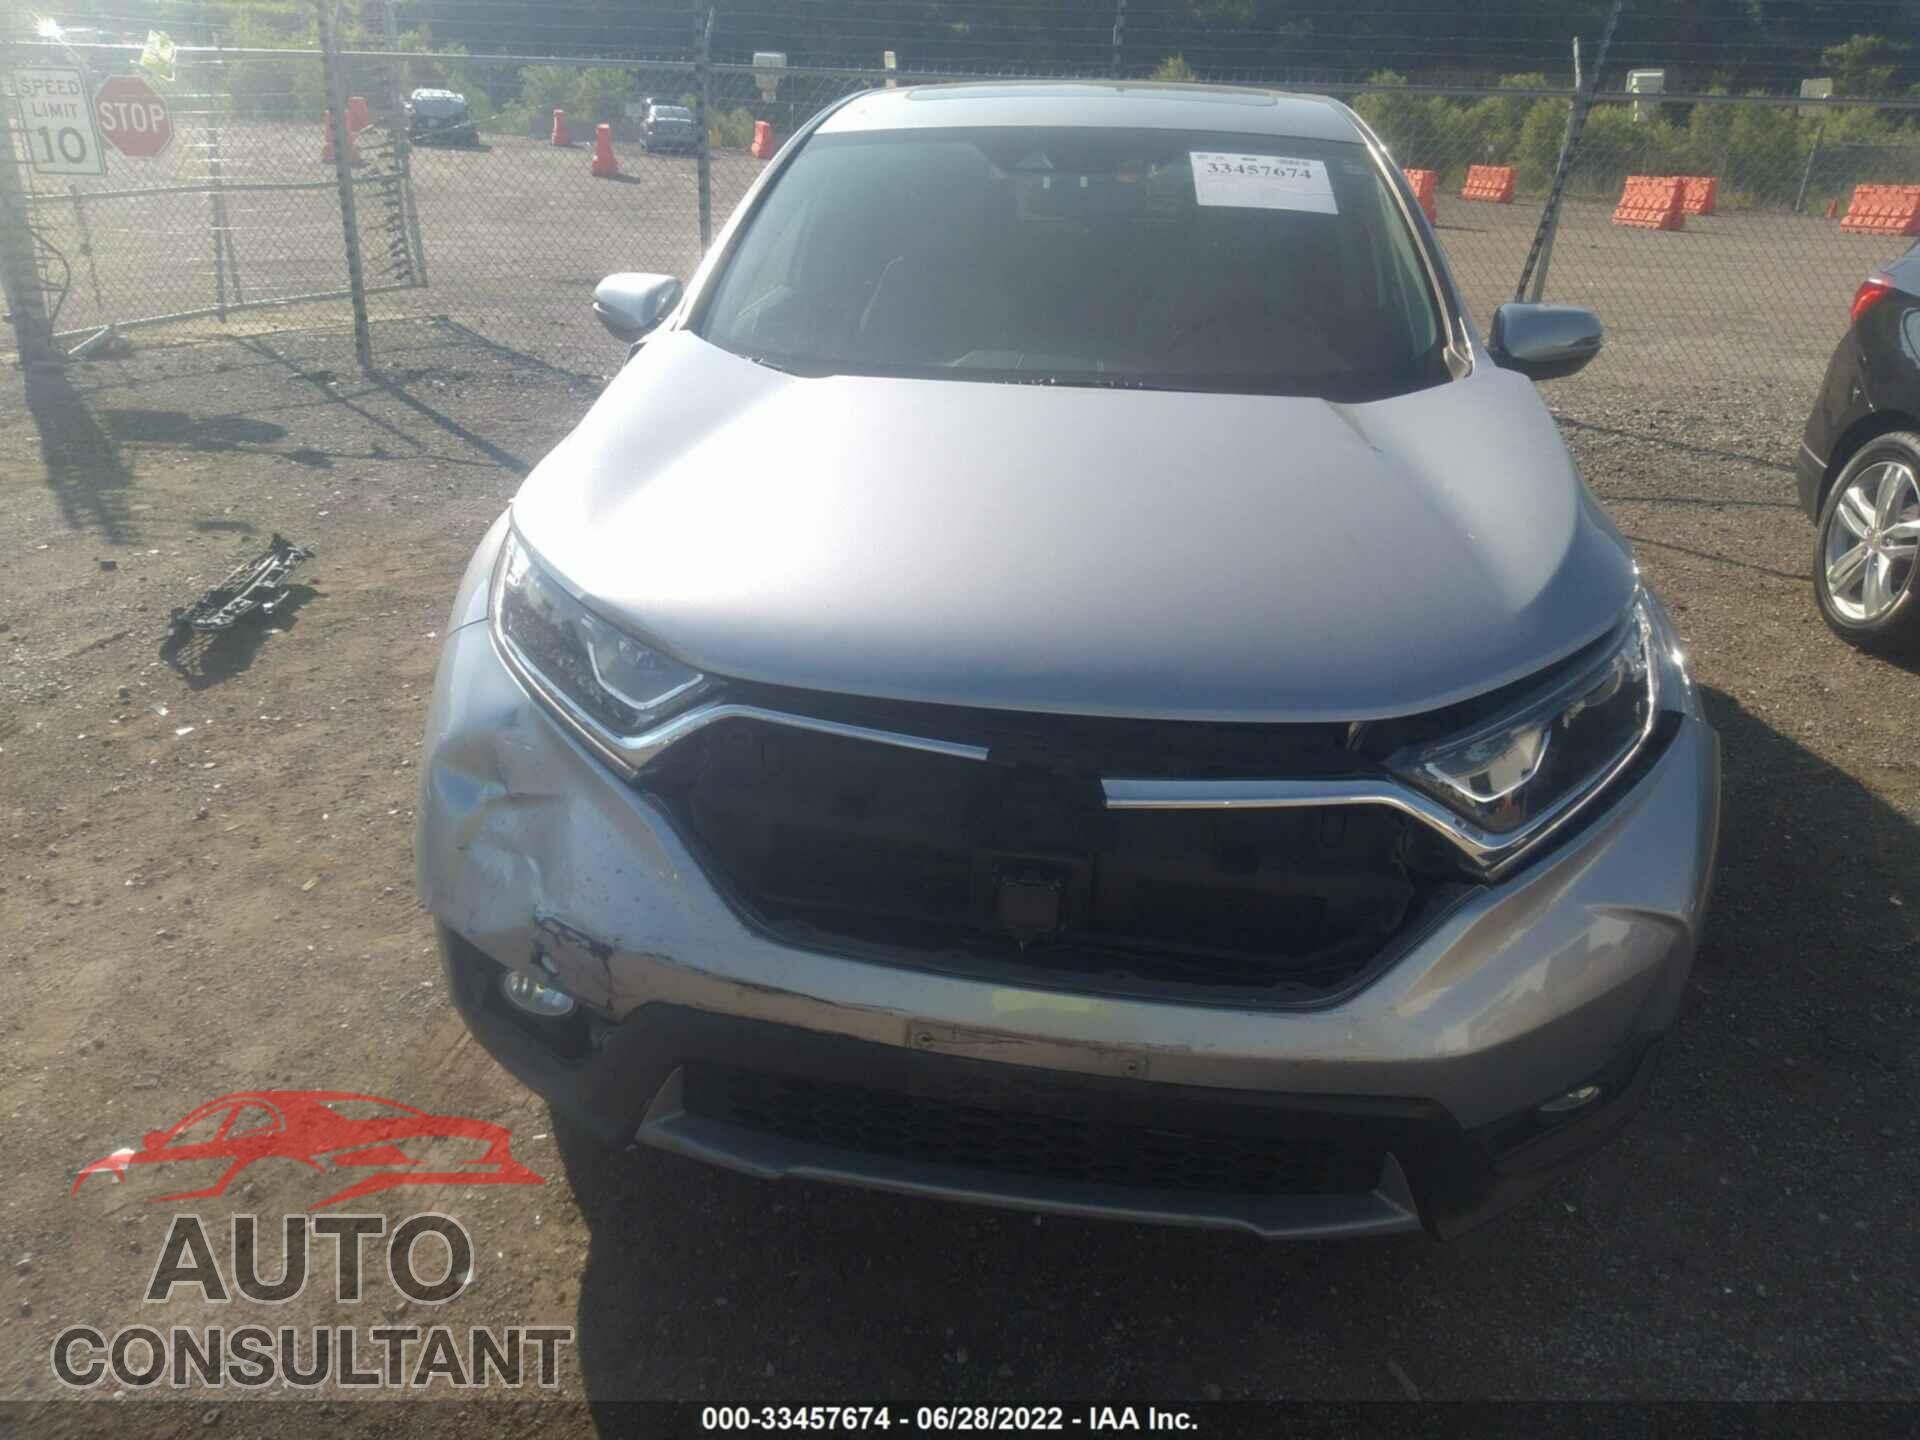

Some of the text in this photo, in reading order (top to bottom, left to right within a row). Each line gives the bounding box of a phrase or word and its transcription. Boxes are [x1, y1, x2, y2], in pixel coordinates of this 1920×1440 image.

[19, 79, 80, 96] SPEED
[31, 101, 78, 118] LIMIT
[99, 102, 164, 133] STOP
[37, 126, 86, 164] 10
[1207, 162, 1312, 180] 33457674
